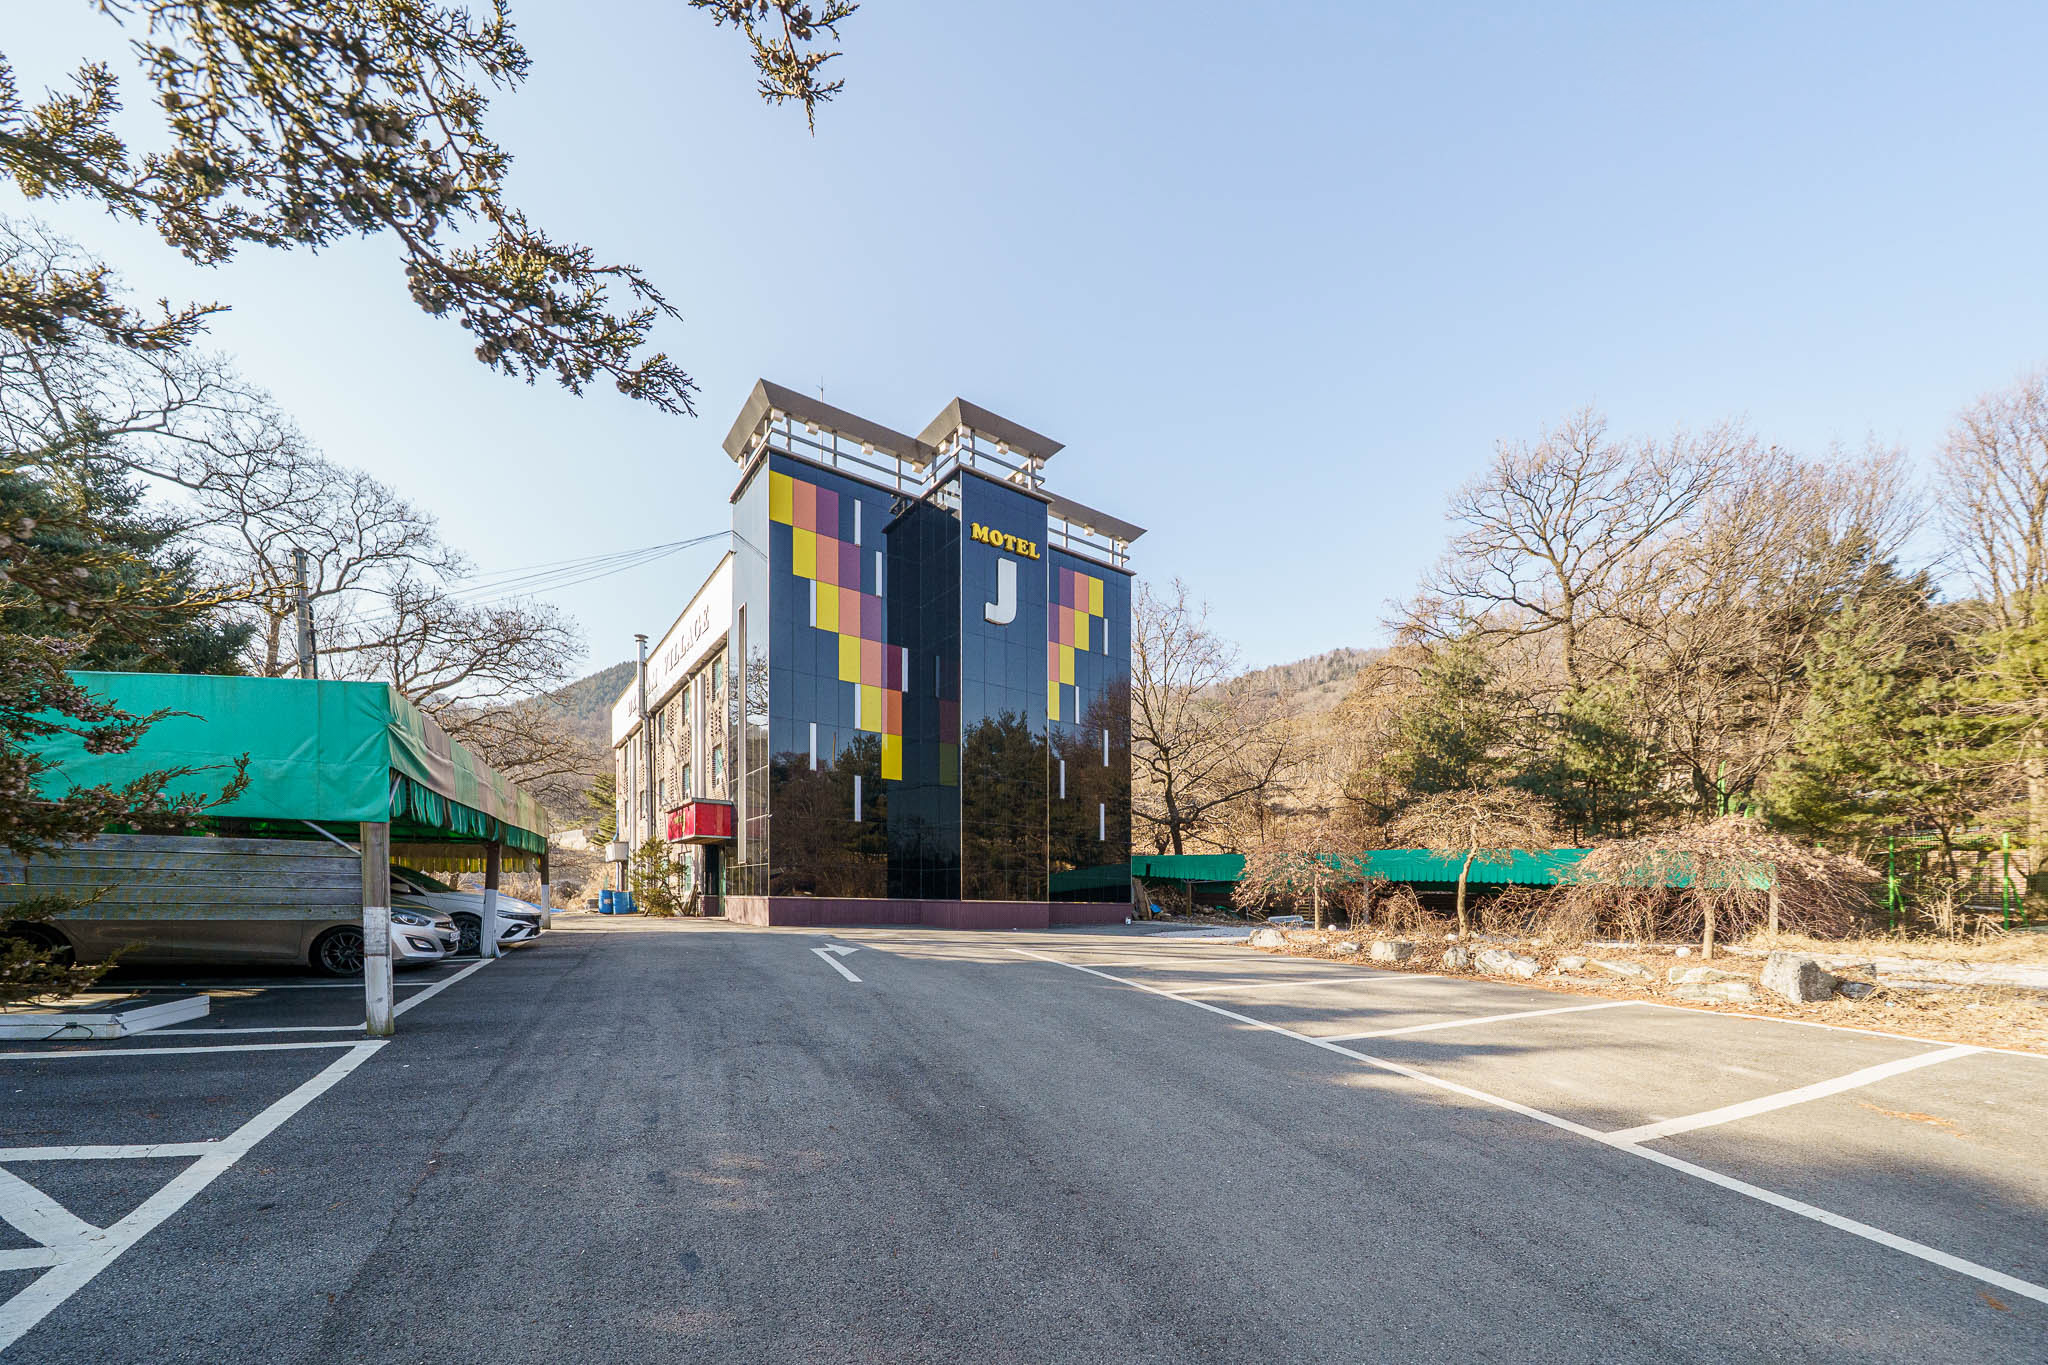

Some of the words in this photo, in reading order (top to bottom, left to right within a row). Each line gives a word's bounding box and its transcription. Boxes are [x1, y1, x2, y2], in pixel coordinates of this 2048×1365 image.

[970, 522, 1040, 560] MOTEL
[984, 557, 1017, 625] J
[664, 603, 710, 676] VILLAGE
